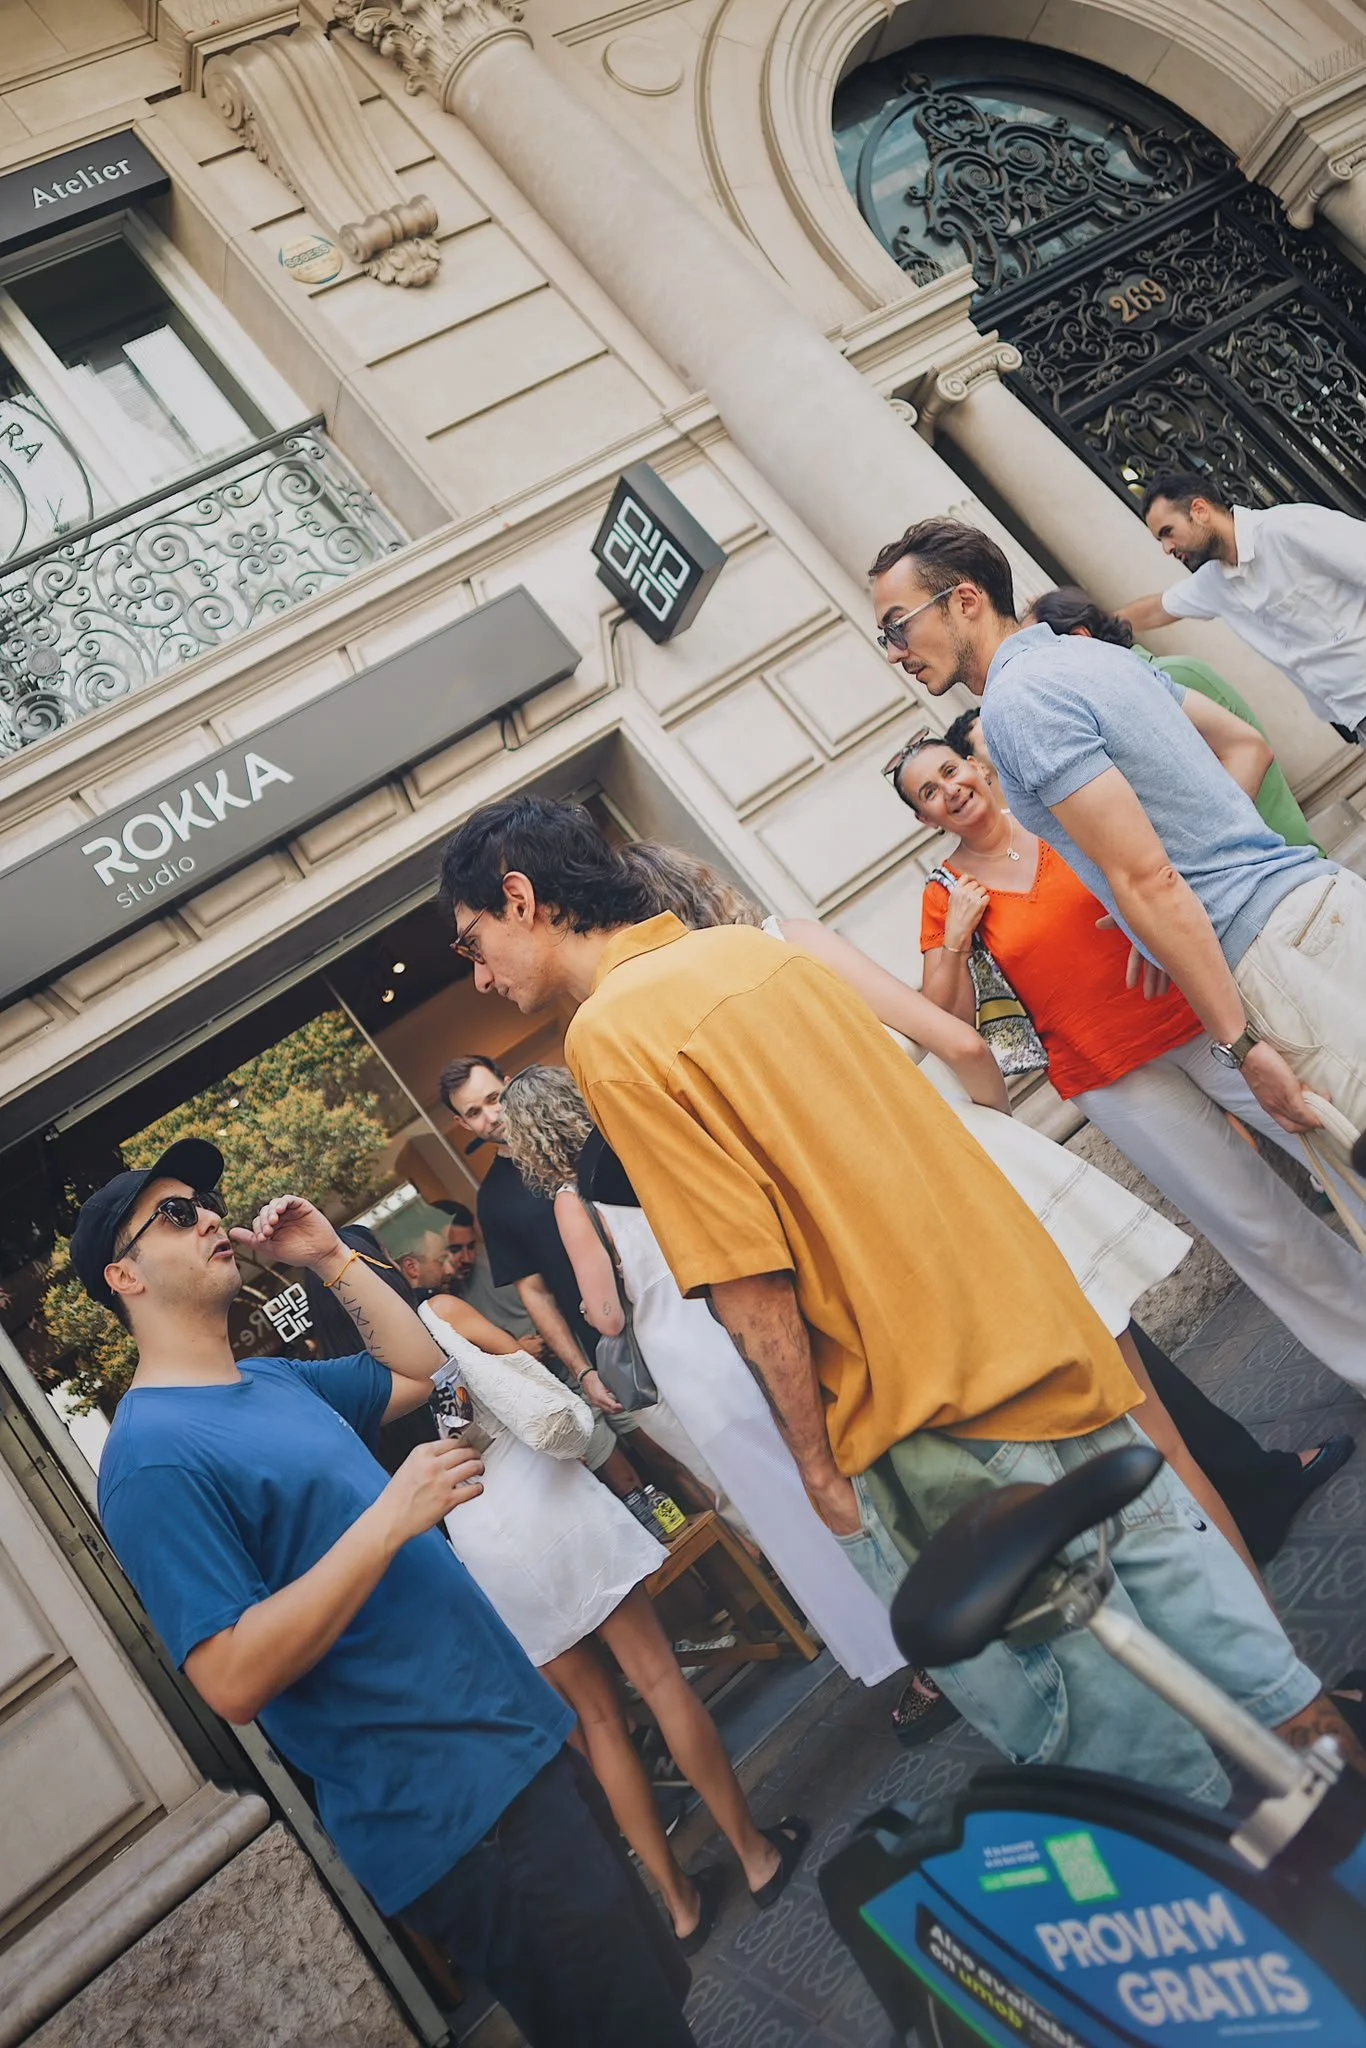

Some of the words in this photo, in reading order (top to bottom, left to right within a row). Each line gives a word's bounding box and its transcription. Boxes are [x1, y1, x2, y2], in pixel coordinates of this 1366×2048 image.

[32, 160, 131, 209] Atelier
[1109, 279, 1166, 324] 269
[0, 415, 43, 463] RA
[81, 753, 294, 886] ROKKA
[116, 856, 195, 908] studio
[1035, 1892, 1246, 1972] PROVA'M
[930, 1942, 956, 1974] on
[958, 1969, 1023, 2029] umob
[930, 1924, 976, 1971] Also
[977, 1968, 1085, 2048] availabl
[1117, 1952, 1311, 2026] GRATIS
